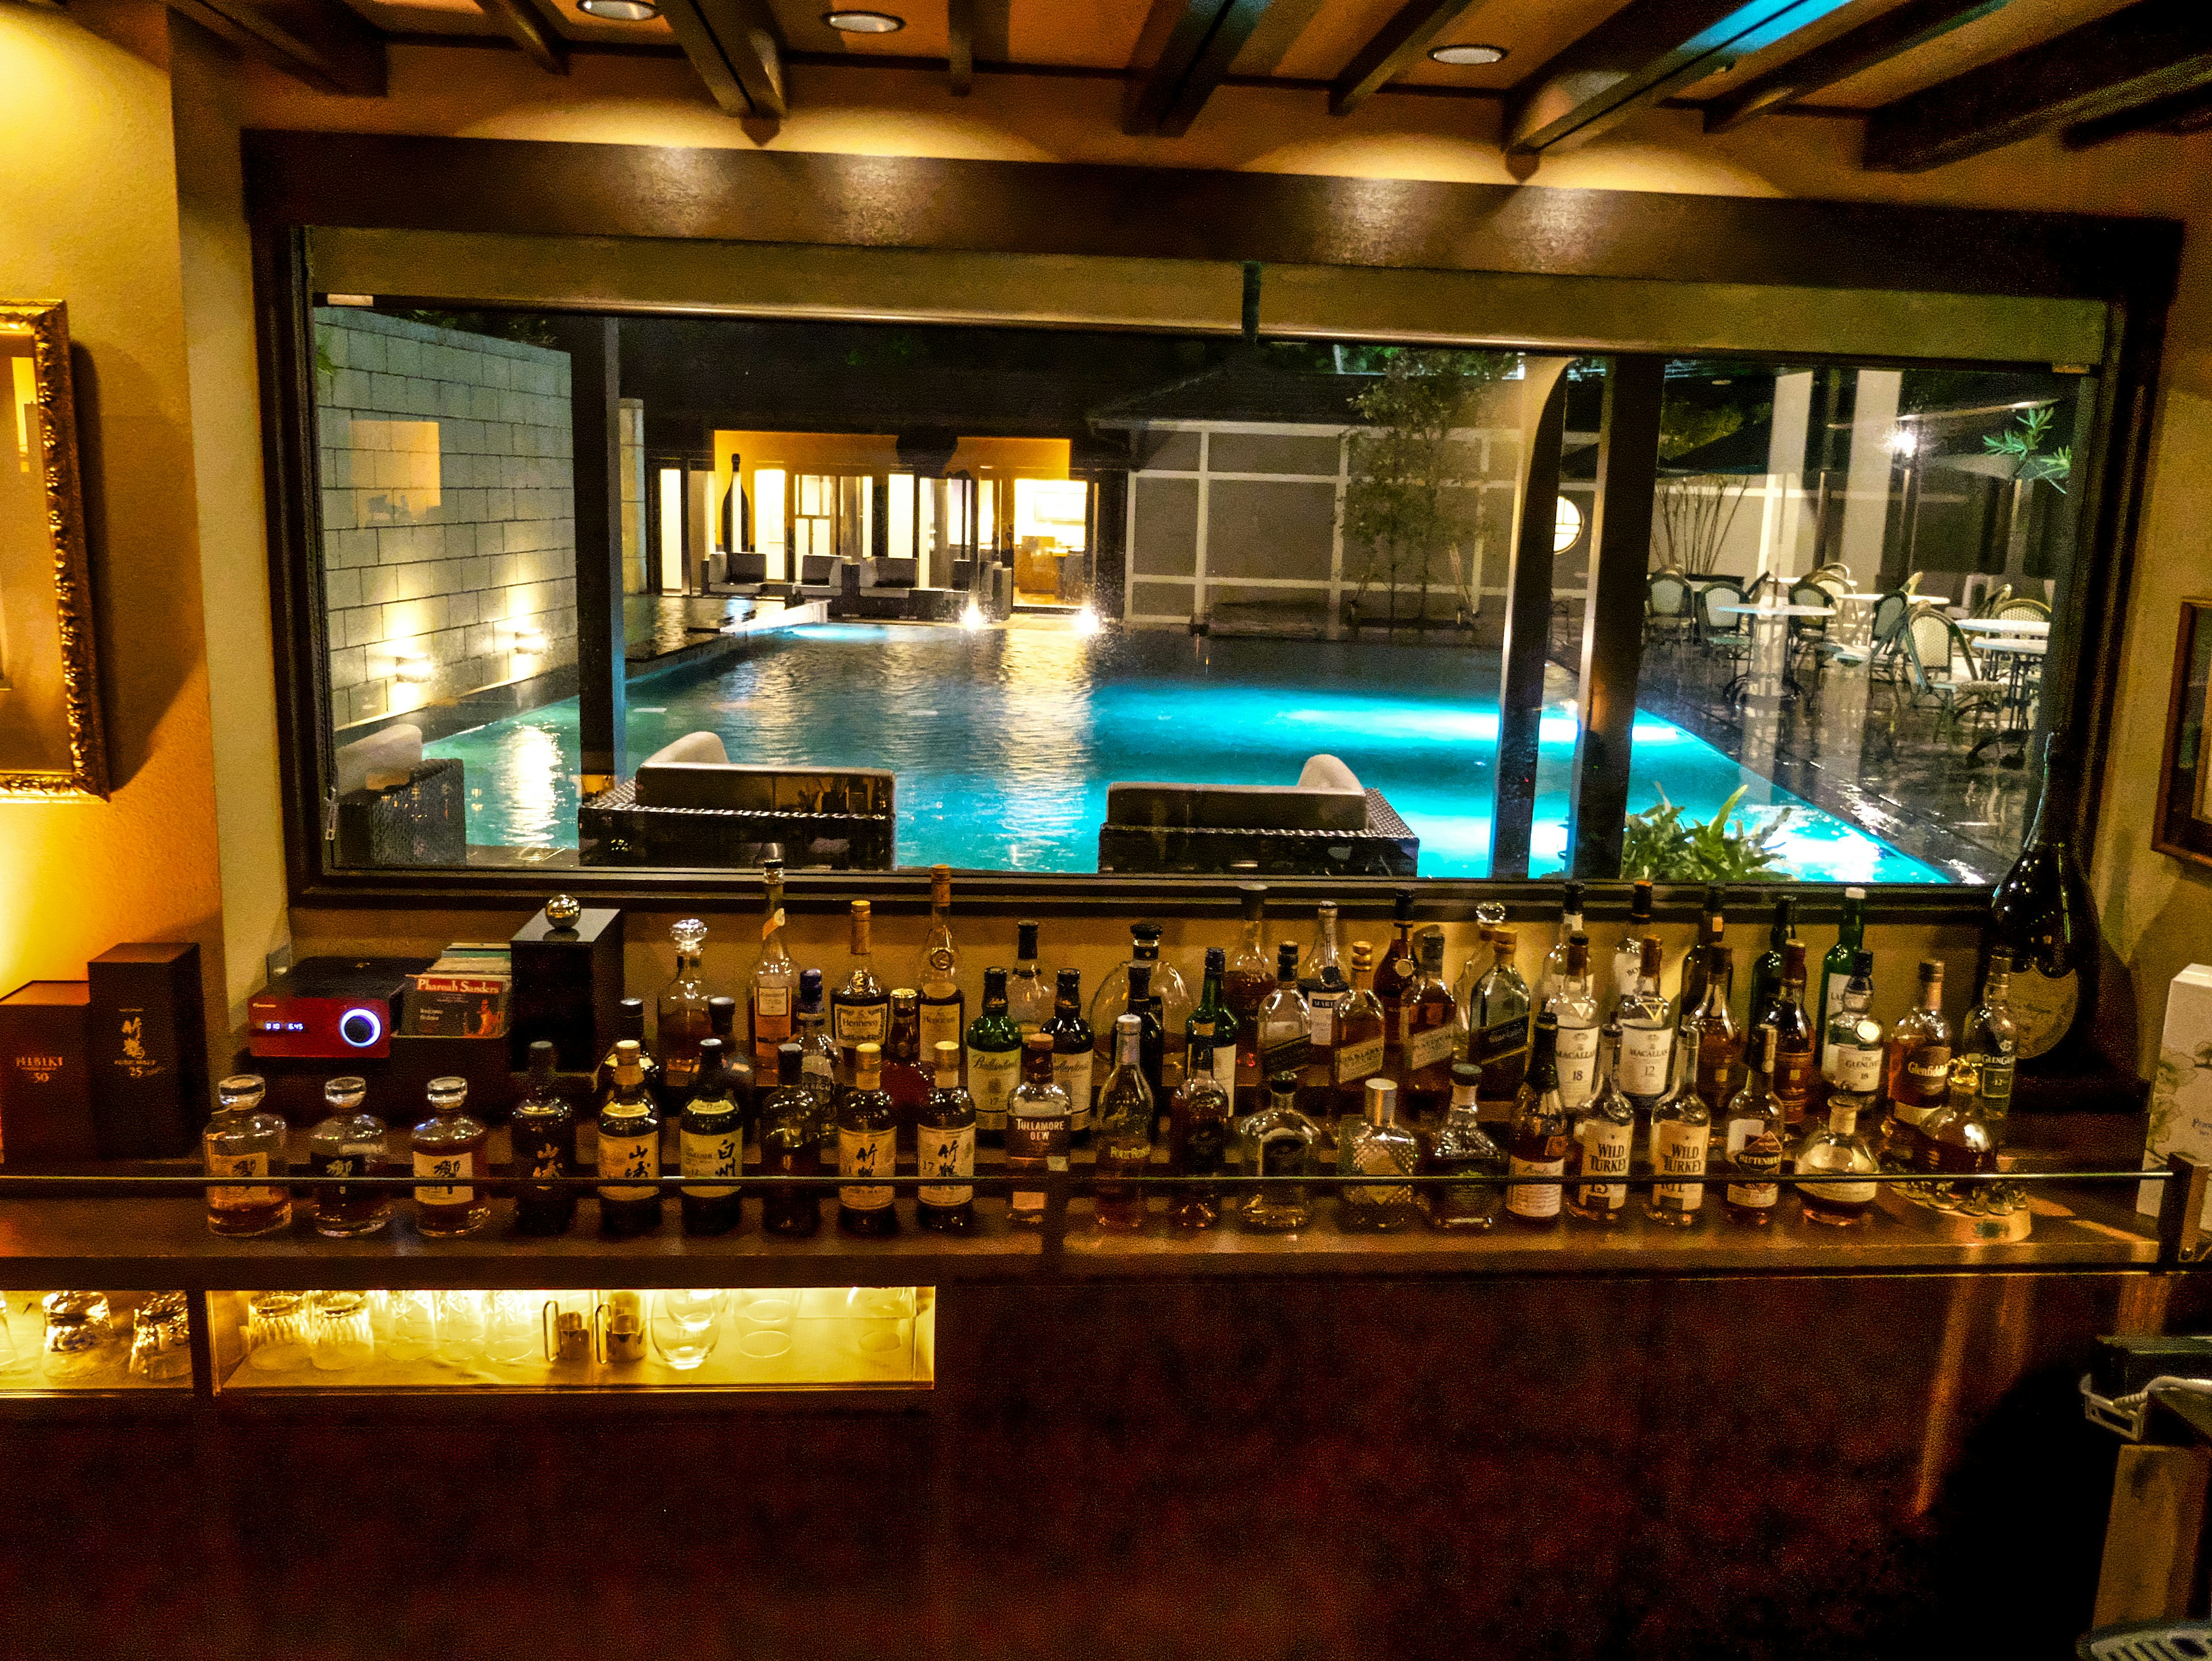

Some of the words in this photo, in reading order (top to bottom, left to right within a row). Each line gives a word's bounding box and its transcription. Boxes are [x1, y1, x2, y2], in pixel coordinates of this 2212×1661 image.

[418, 979, 458, 992] Pharoah
[460, 981, 499, 994] Sanders
[843, 1018, 878, 1027] Hennessy
[16, 1057, 63, 1066] HIBIKI
[1573, 1070, 1583, 1081] 18
[1645, 1066, 1655, 1076] 12
[1016, 1118, 1065, 1131] TULLAMORE
[1598, 1143, 1624, 1158] WILD
[1672, 1144, 1699, 1159] WILD
[923, 1161, 934, 1171] 17
